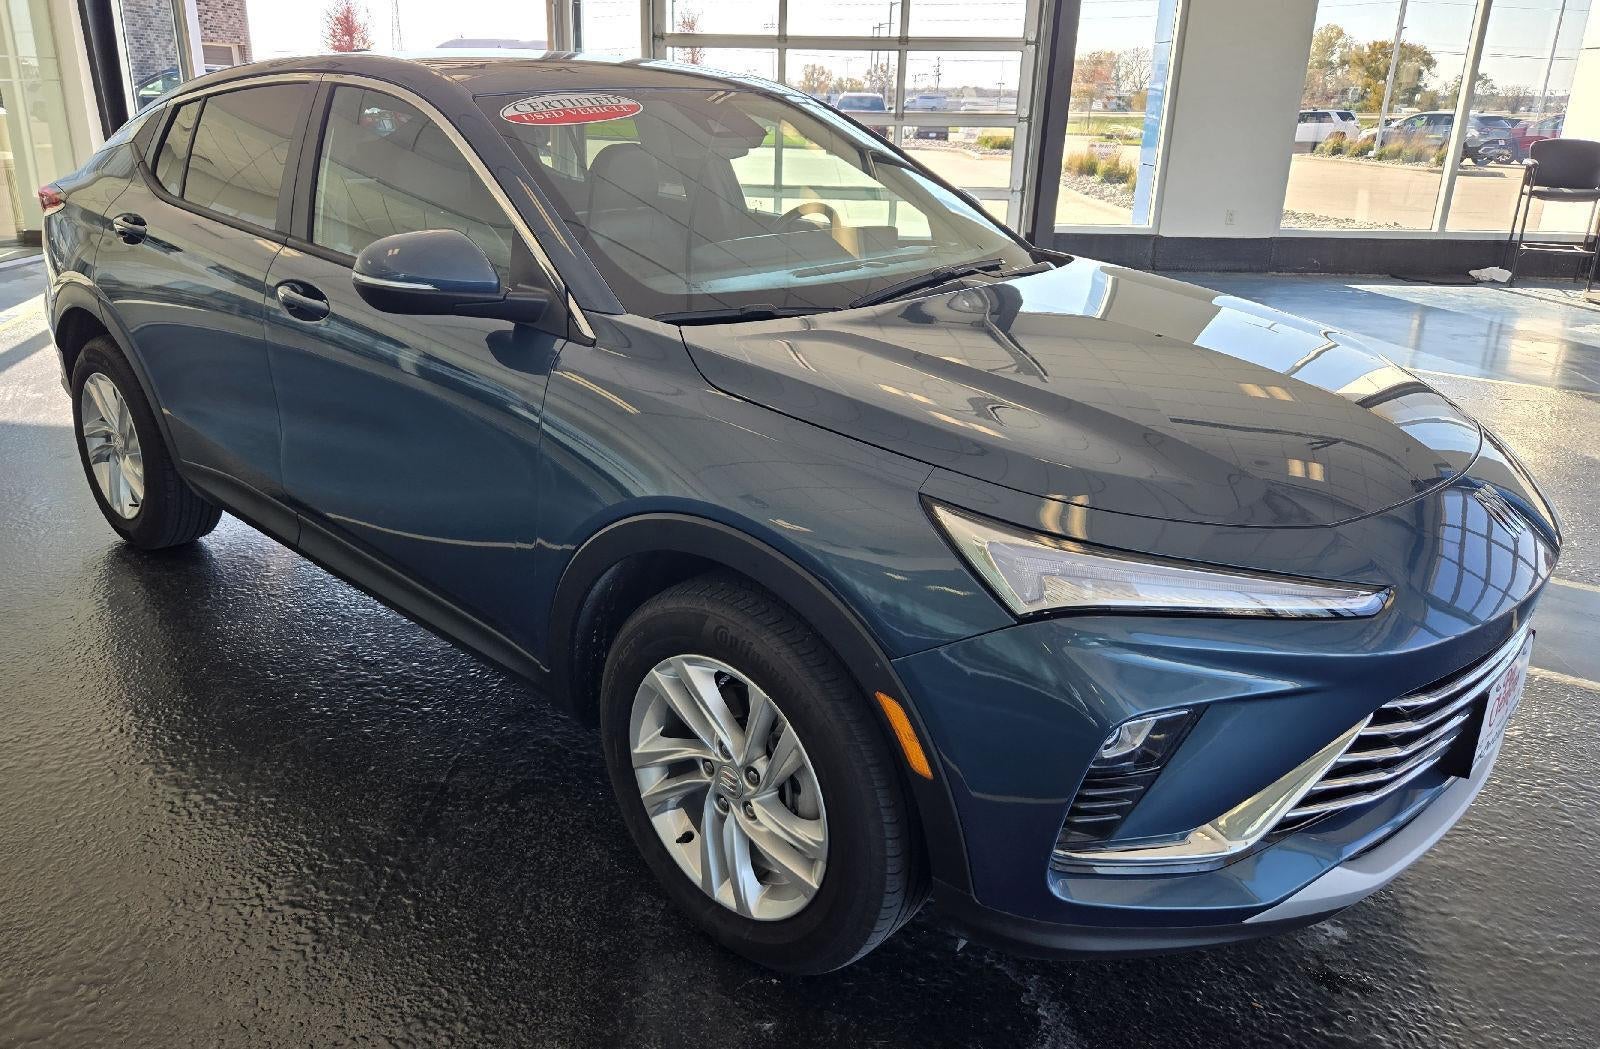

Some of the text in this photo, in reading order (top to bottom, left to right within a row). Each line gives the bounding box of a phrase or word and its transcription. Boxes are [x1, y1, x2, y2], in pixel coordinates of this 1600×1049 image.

[513, 96, 621, 113] CERTIFIED
[522, 103, 632, 121] USED VEHICLE
